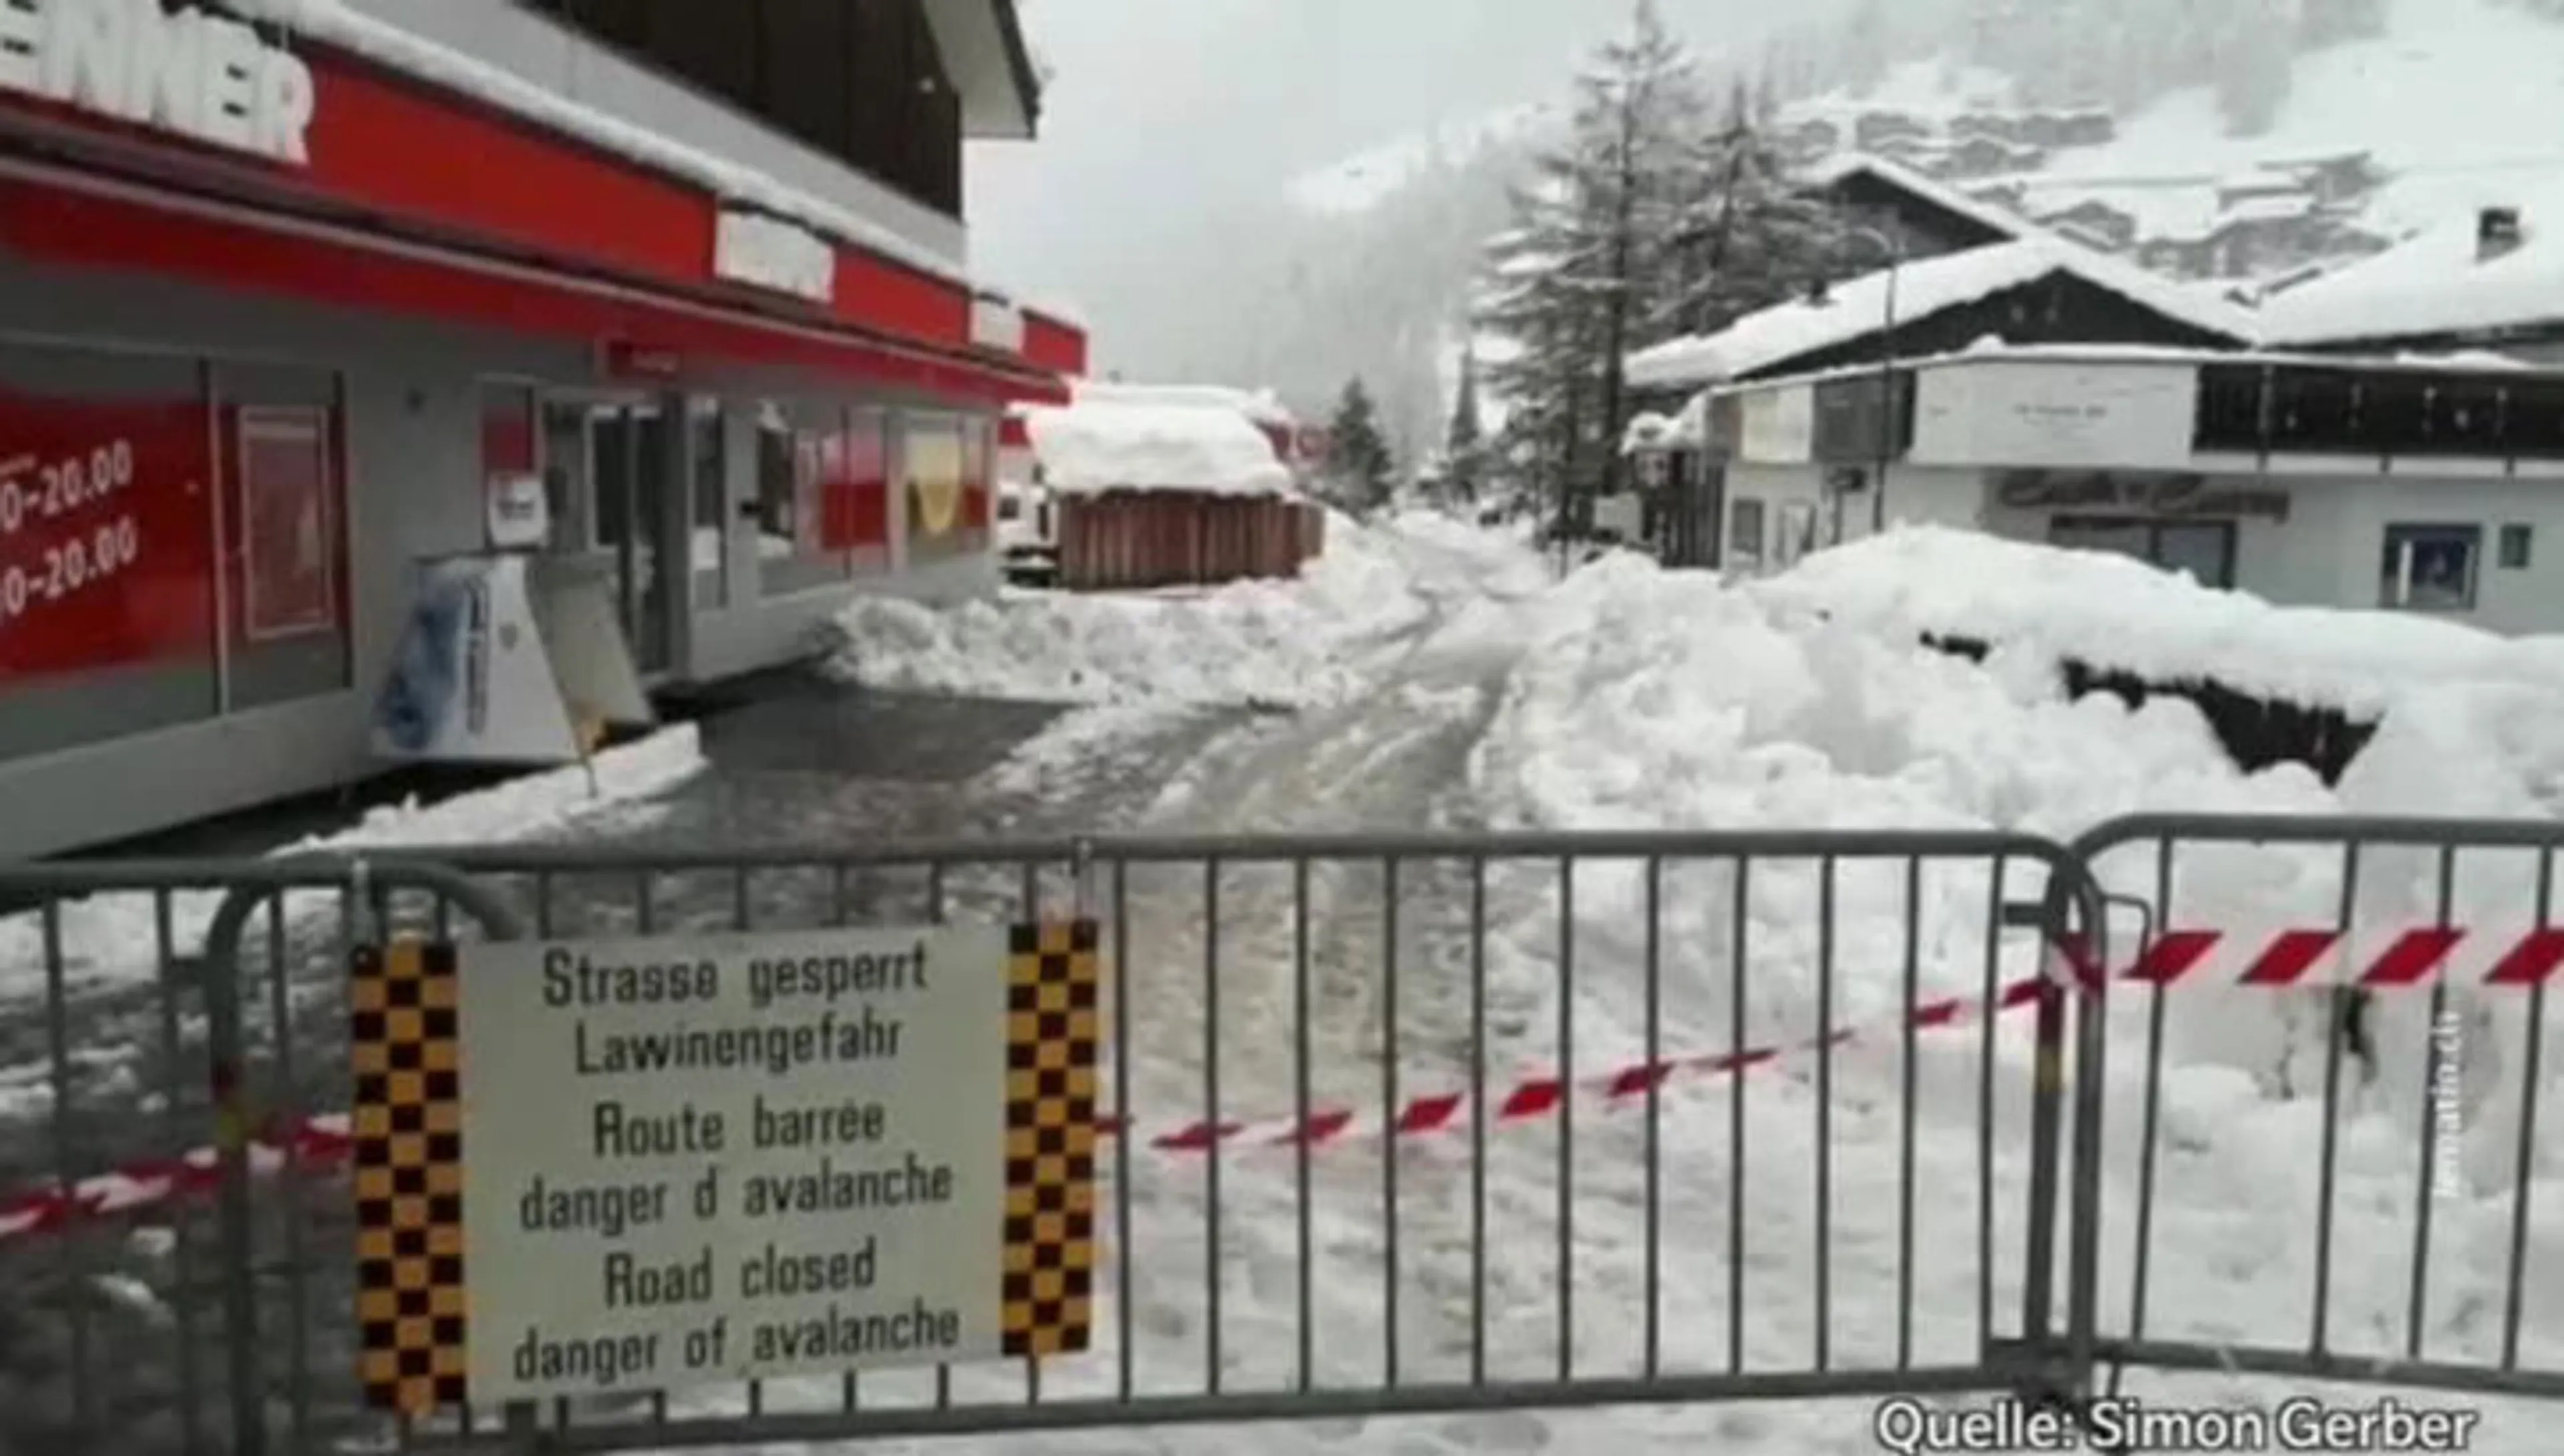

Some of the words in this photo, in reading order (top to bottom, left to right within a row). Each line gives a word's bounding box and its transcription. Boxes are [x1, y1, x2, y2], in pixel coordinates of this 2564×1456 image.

[0, 514, 138, 618] 0-20.00
[542, 947, 718, 1007] Strasse
[749, 939, 929, 1007] gesperrt
[576, 1004, 903, 1075] Lawinengefahr
[594, 1101, 724, 1157] Route
[519, 1174, 668, 1237] danger
[742, 1151, 952, 1217] avalanche
[604, 1244, 712, 1308] Road
[740, 1235, 876, 1298] closed
[513, 1325, 658, 1383] danger
[684, 1314, 728, 1368] of
[753, 1295, 960, 1362] avalanche
